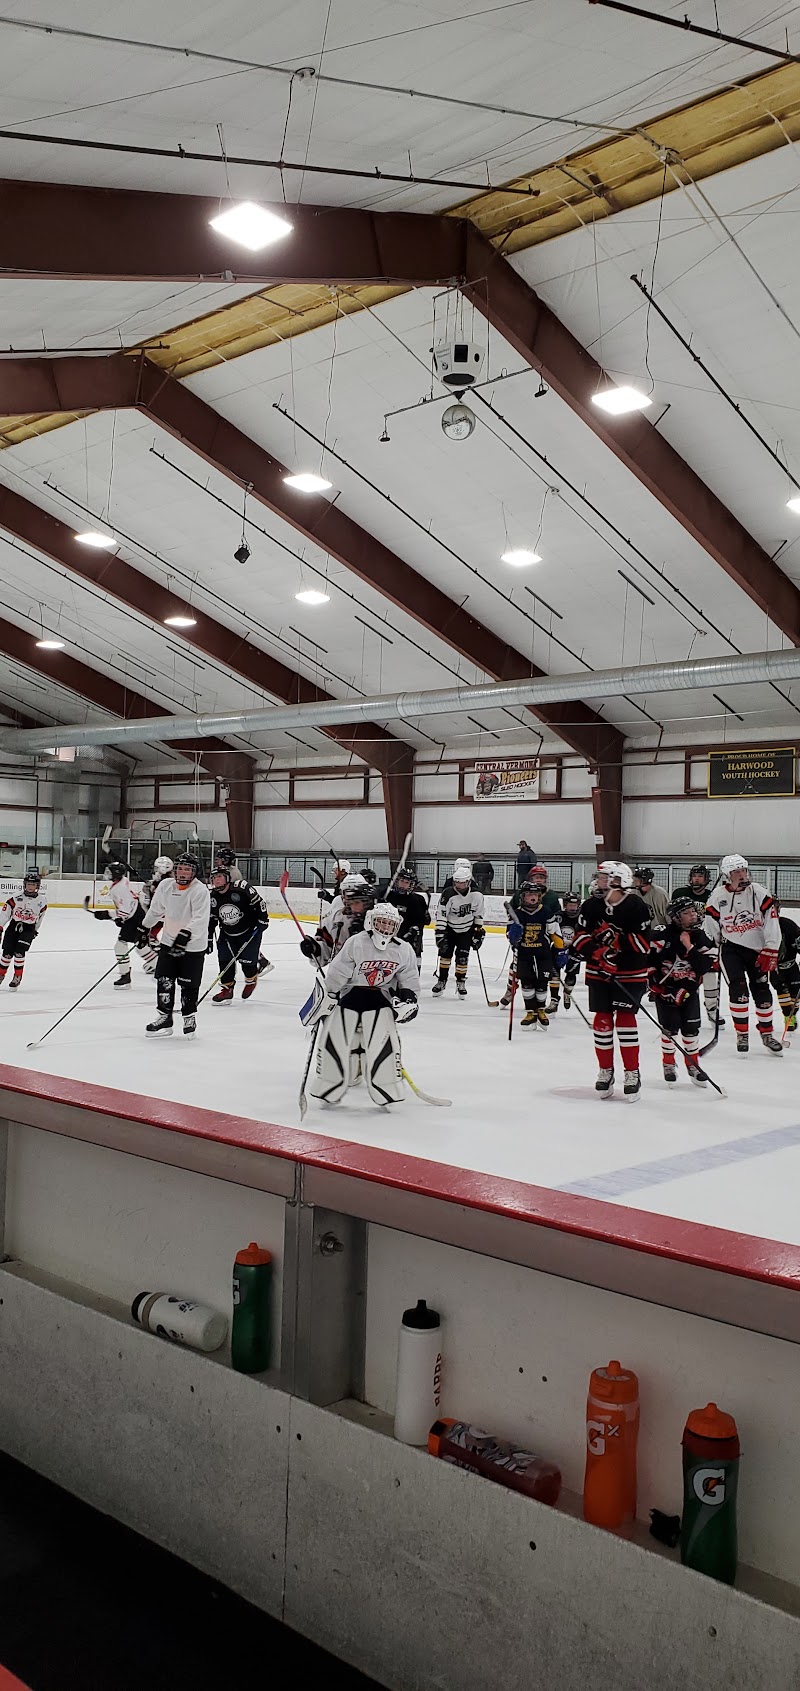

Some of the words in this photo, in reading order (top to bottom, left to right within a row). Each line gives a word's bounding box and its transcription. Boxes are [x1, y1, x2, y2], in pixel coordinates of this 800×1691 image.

[476, 762, 504, 771] CENTRAL
[506, 760, 538, 770] VERMONT
[728, 761, 774, 770] HARWOOD
[500, 769, 538, 785] Pioneers
[361, 961, 399, 970] BLADES
[612, 1001, 633, 1009] CCM
